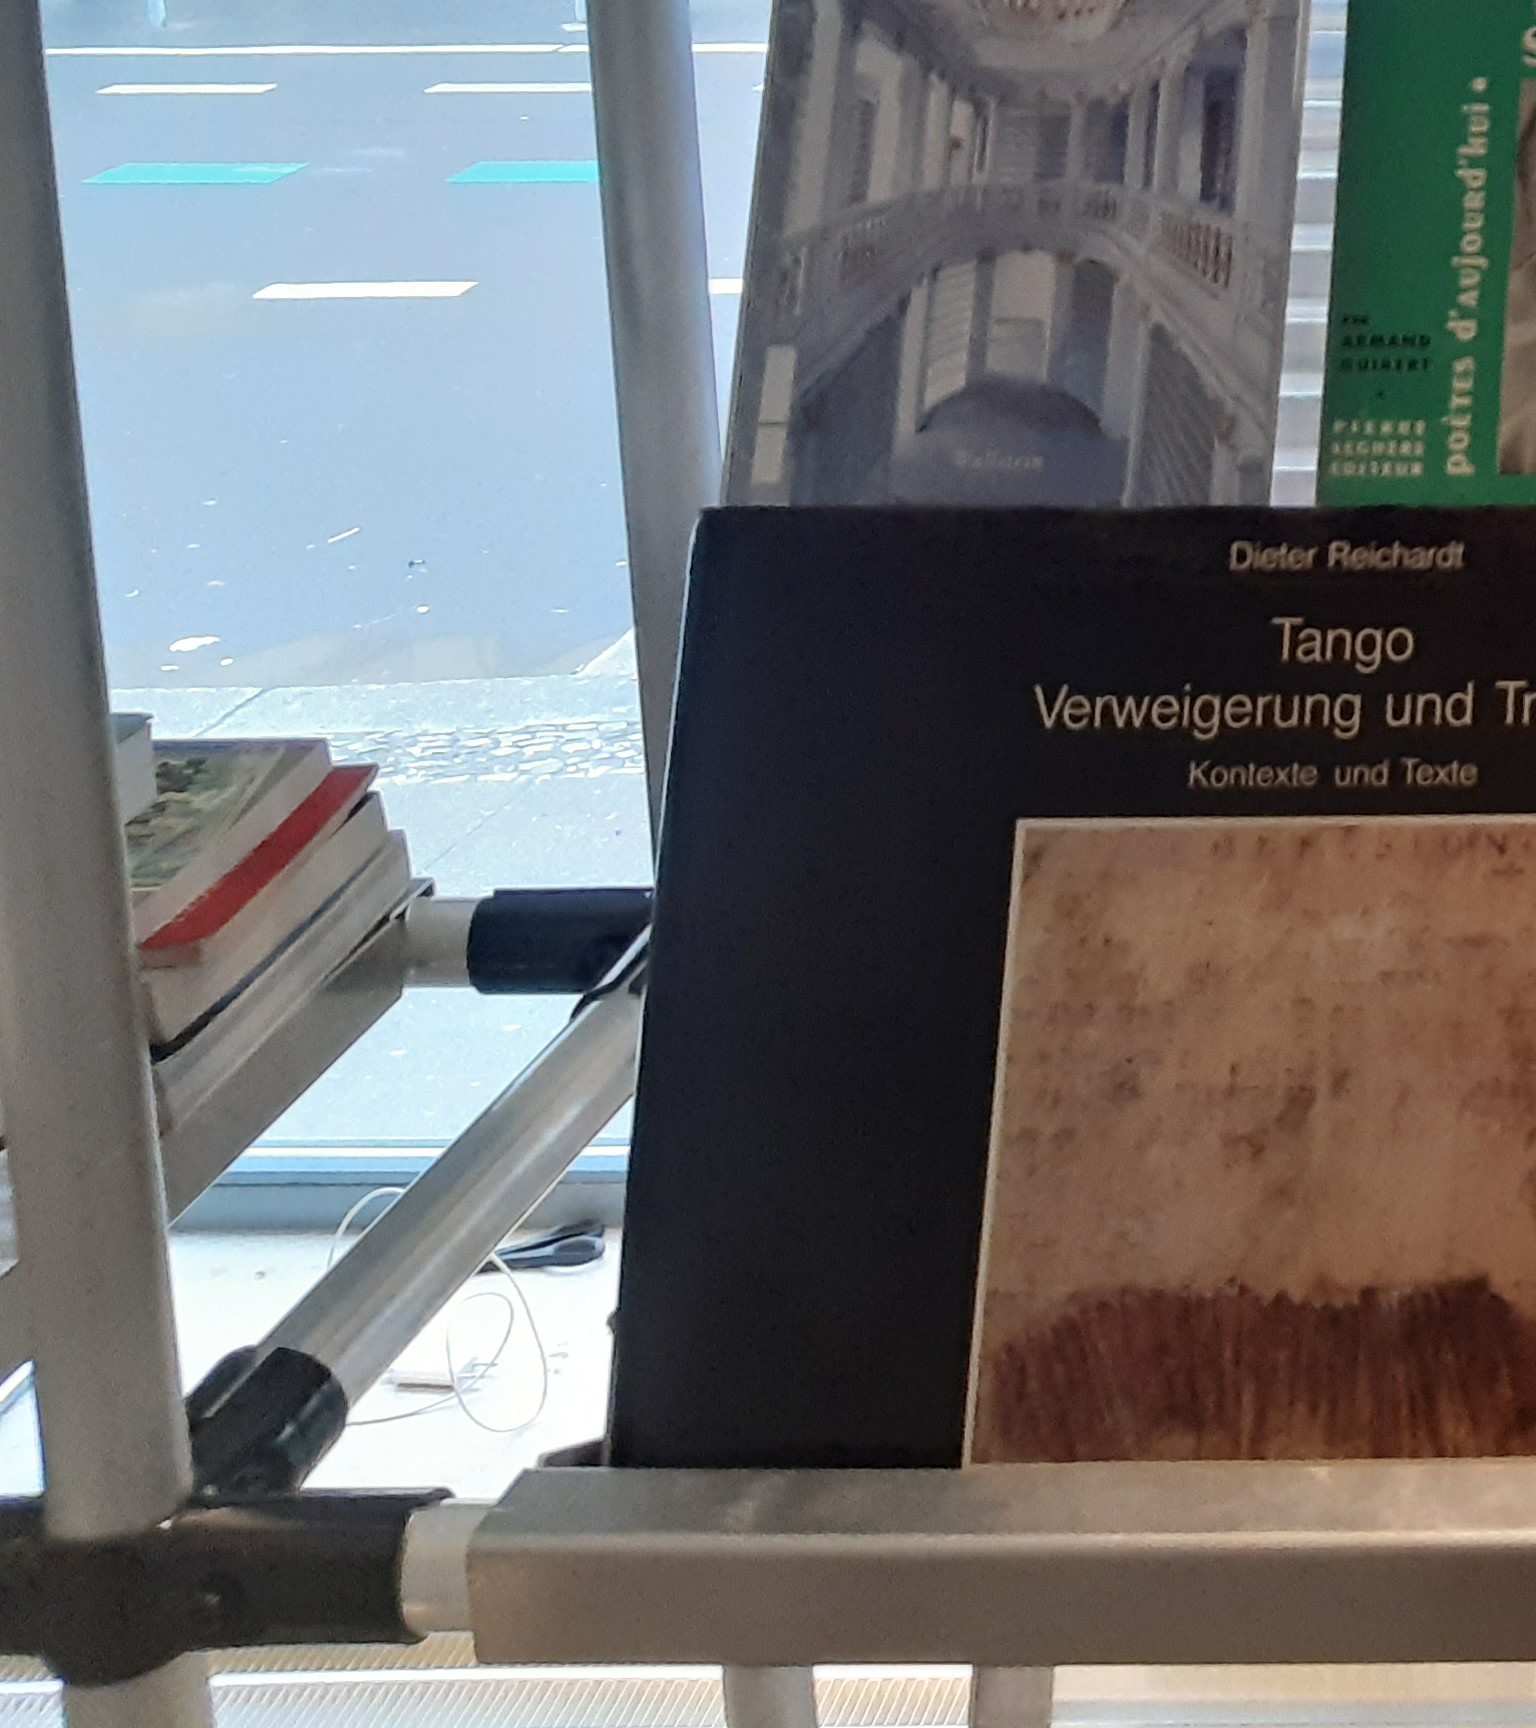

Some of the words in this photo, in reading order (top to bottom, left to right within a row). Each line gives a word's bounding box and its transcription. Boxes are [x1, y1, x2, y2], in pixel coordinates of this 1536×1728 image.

[1229, 541, 1318, 571] Dieter
[1327, 540, 1465, 570] Reichardt
[1271, 617, 1414, 674] Tango
[1034, 684, 1361, 741] Verweigerung
[1386, 681, 1474, 727] und
[1188, 760, 1318, 790] Kontexte
[1334, 760, 1389, 787] und
[1401, 758, 1478, 787] Texte
